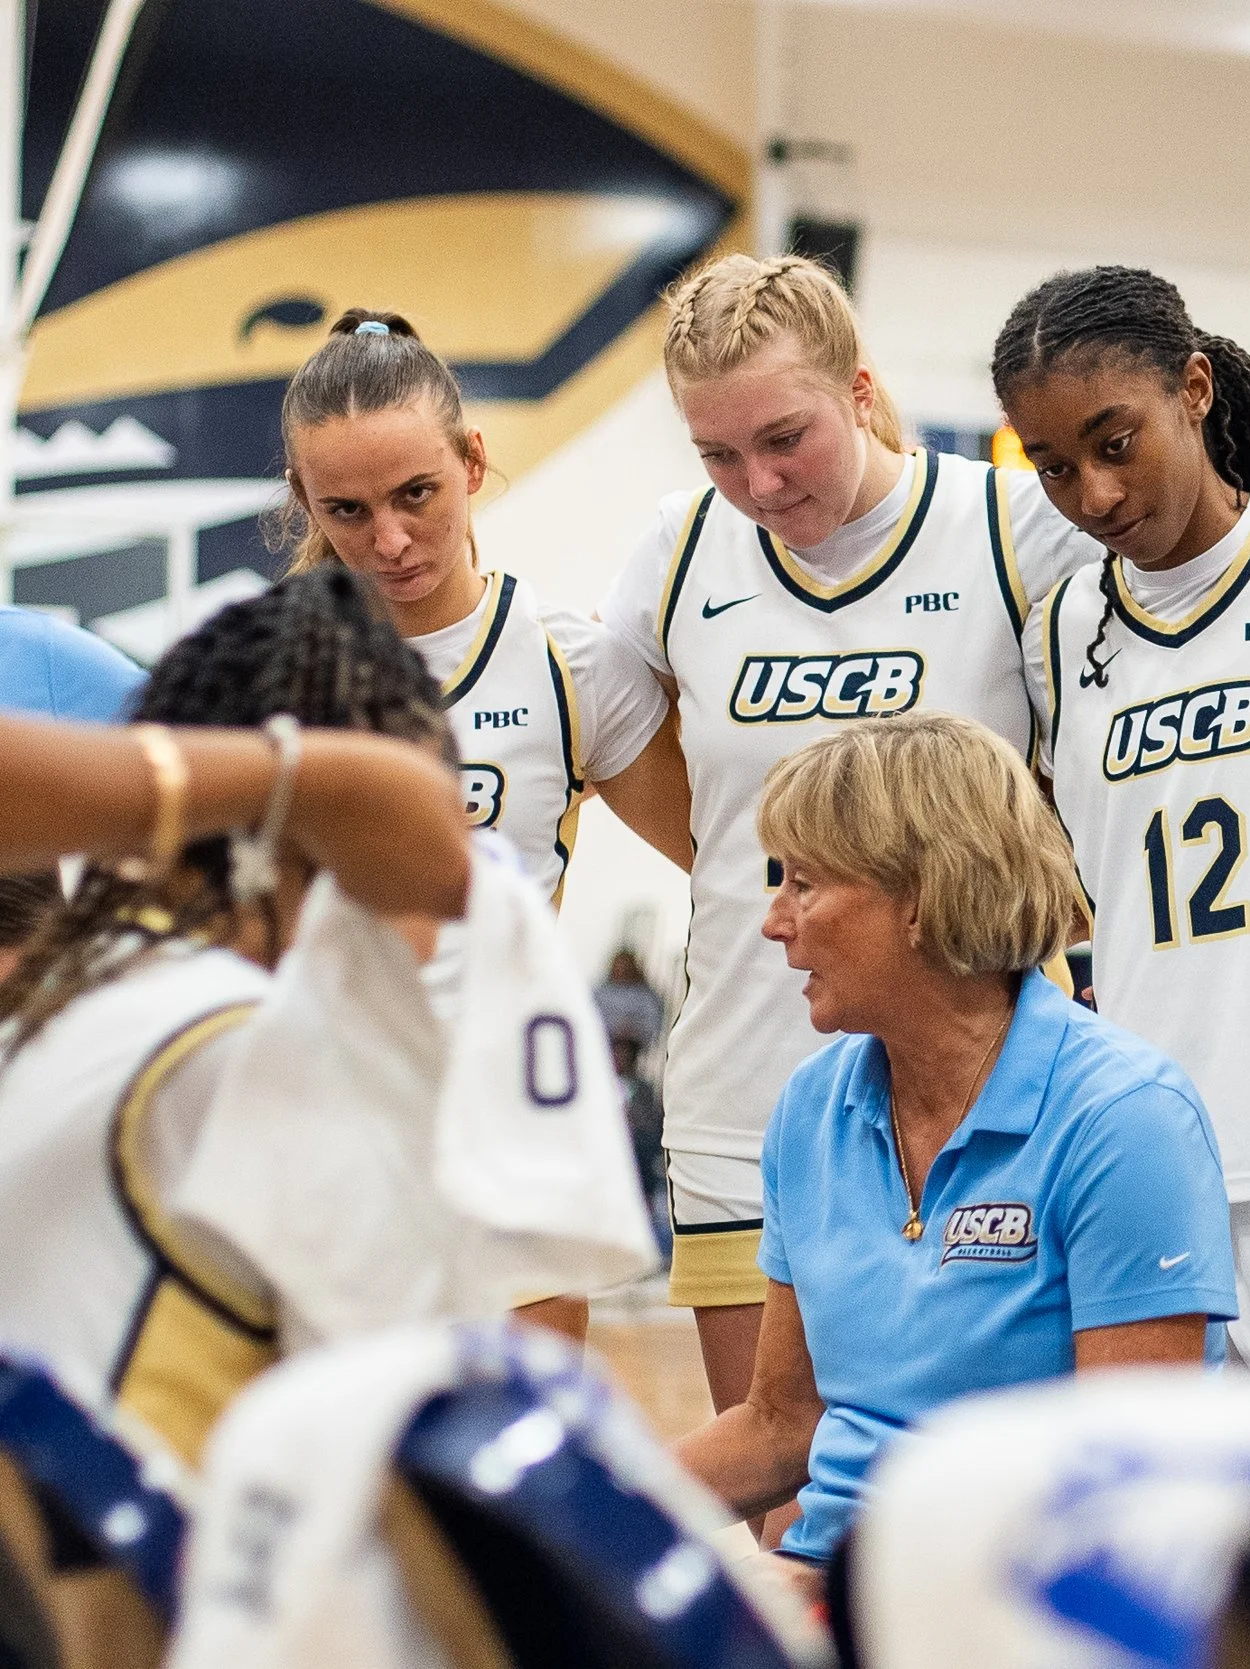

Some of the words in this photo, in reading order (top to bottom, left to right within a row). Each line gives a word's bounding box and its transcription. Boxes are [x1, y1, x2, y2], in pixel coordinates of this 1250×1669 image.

[906, 592, 959, 613] PBC
[731, 652, 923, 721] USCB
[474, 707, 528, 729] PBC
[1143, 795, 1250, 948] 12
[945, 1205, 1030, 1245] USCB
